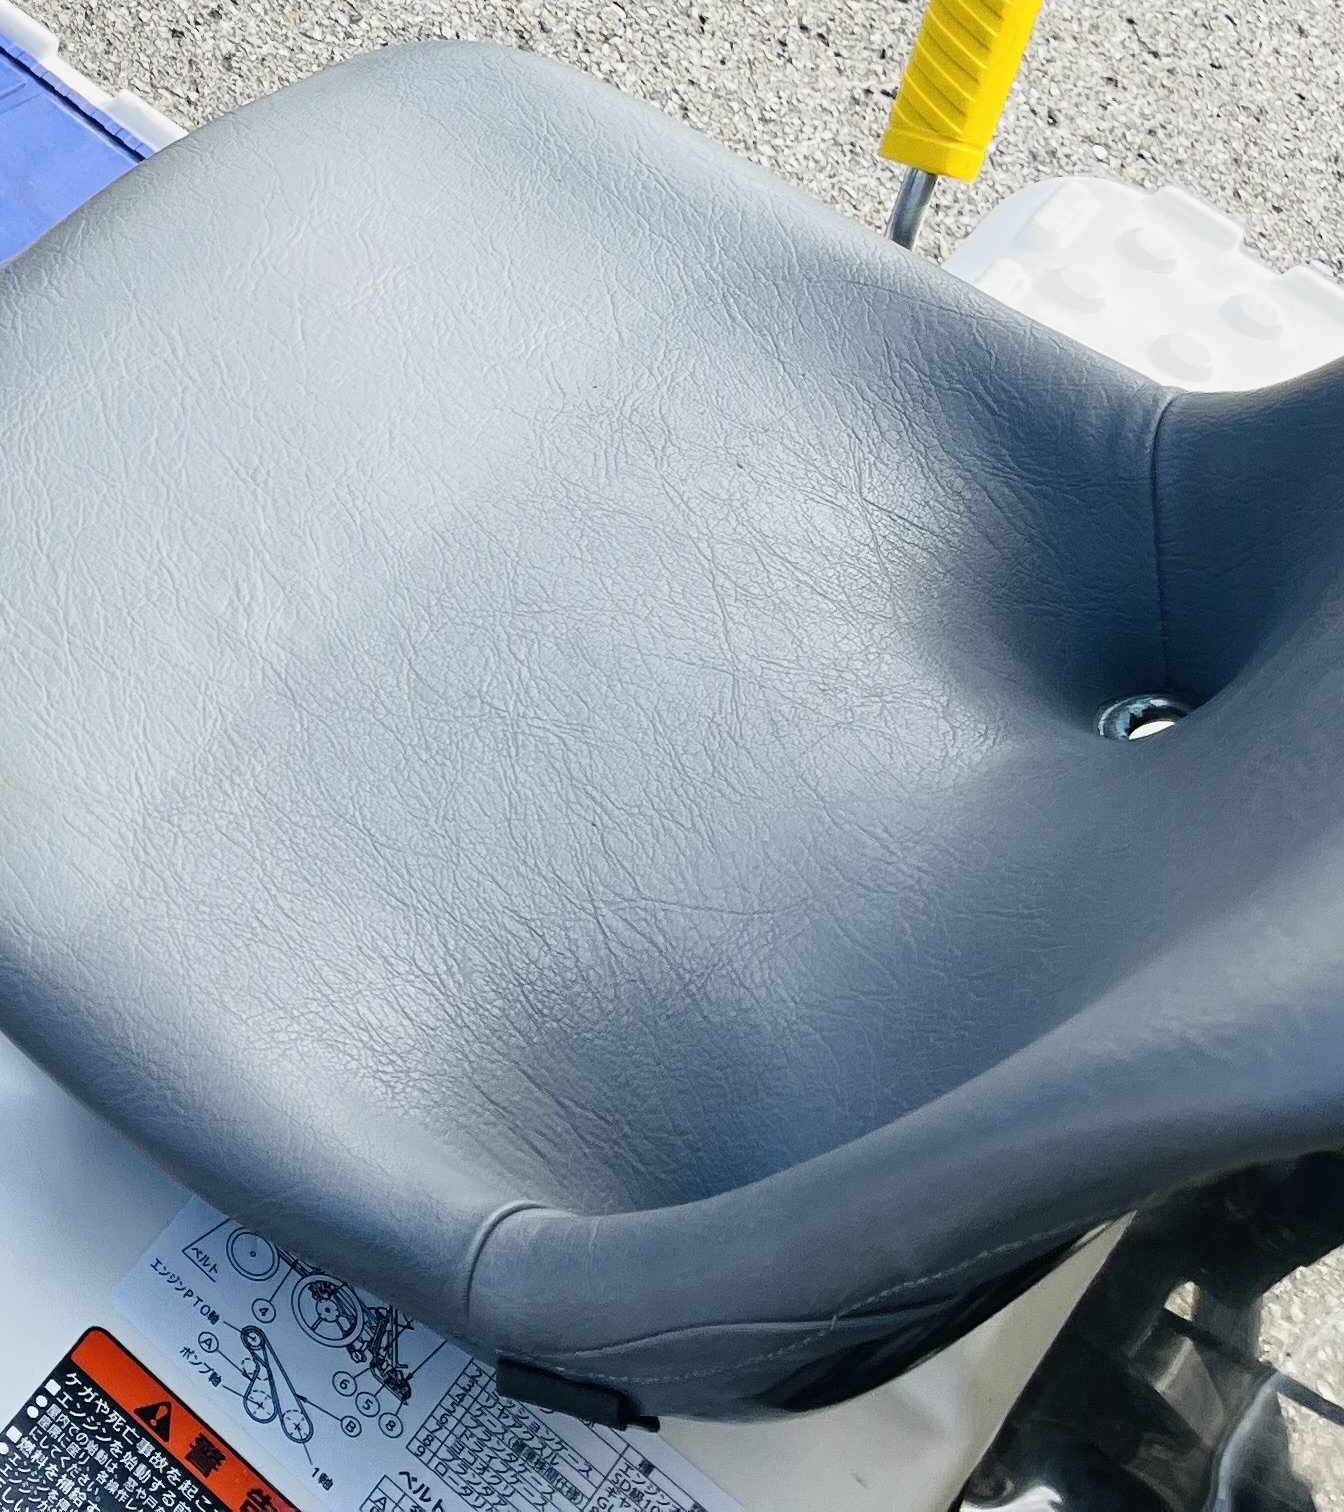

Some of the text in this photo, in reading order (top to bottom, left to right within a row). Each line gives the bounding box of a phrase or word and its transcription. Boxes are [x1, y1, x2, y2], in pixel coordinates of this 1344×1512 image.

[190, 1246, 220, 1276] ベルト
[179, 1346, 223, 1387] ポンプ軸
[29, 1426, 101, 1502] にしてください。
[37, 1414, 143, 1512] 座席に座り、各操作レ
[64, 1372, 220, 1512] ケガや死亡事故を起こ
[312, 1467, 334, 1491] 1軸
[434, 1461, 495, 1512] ロータリ
